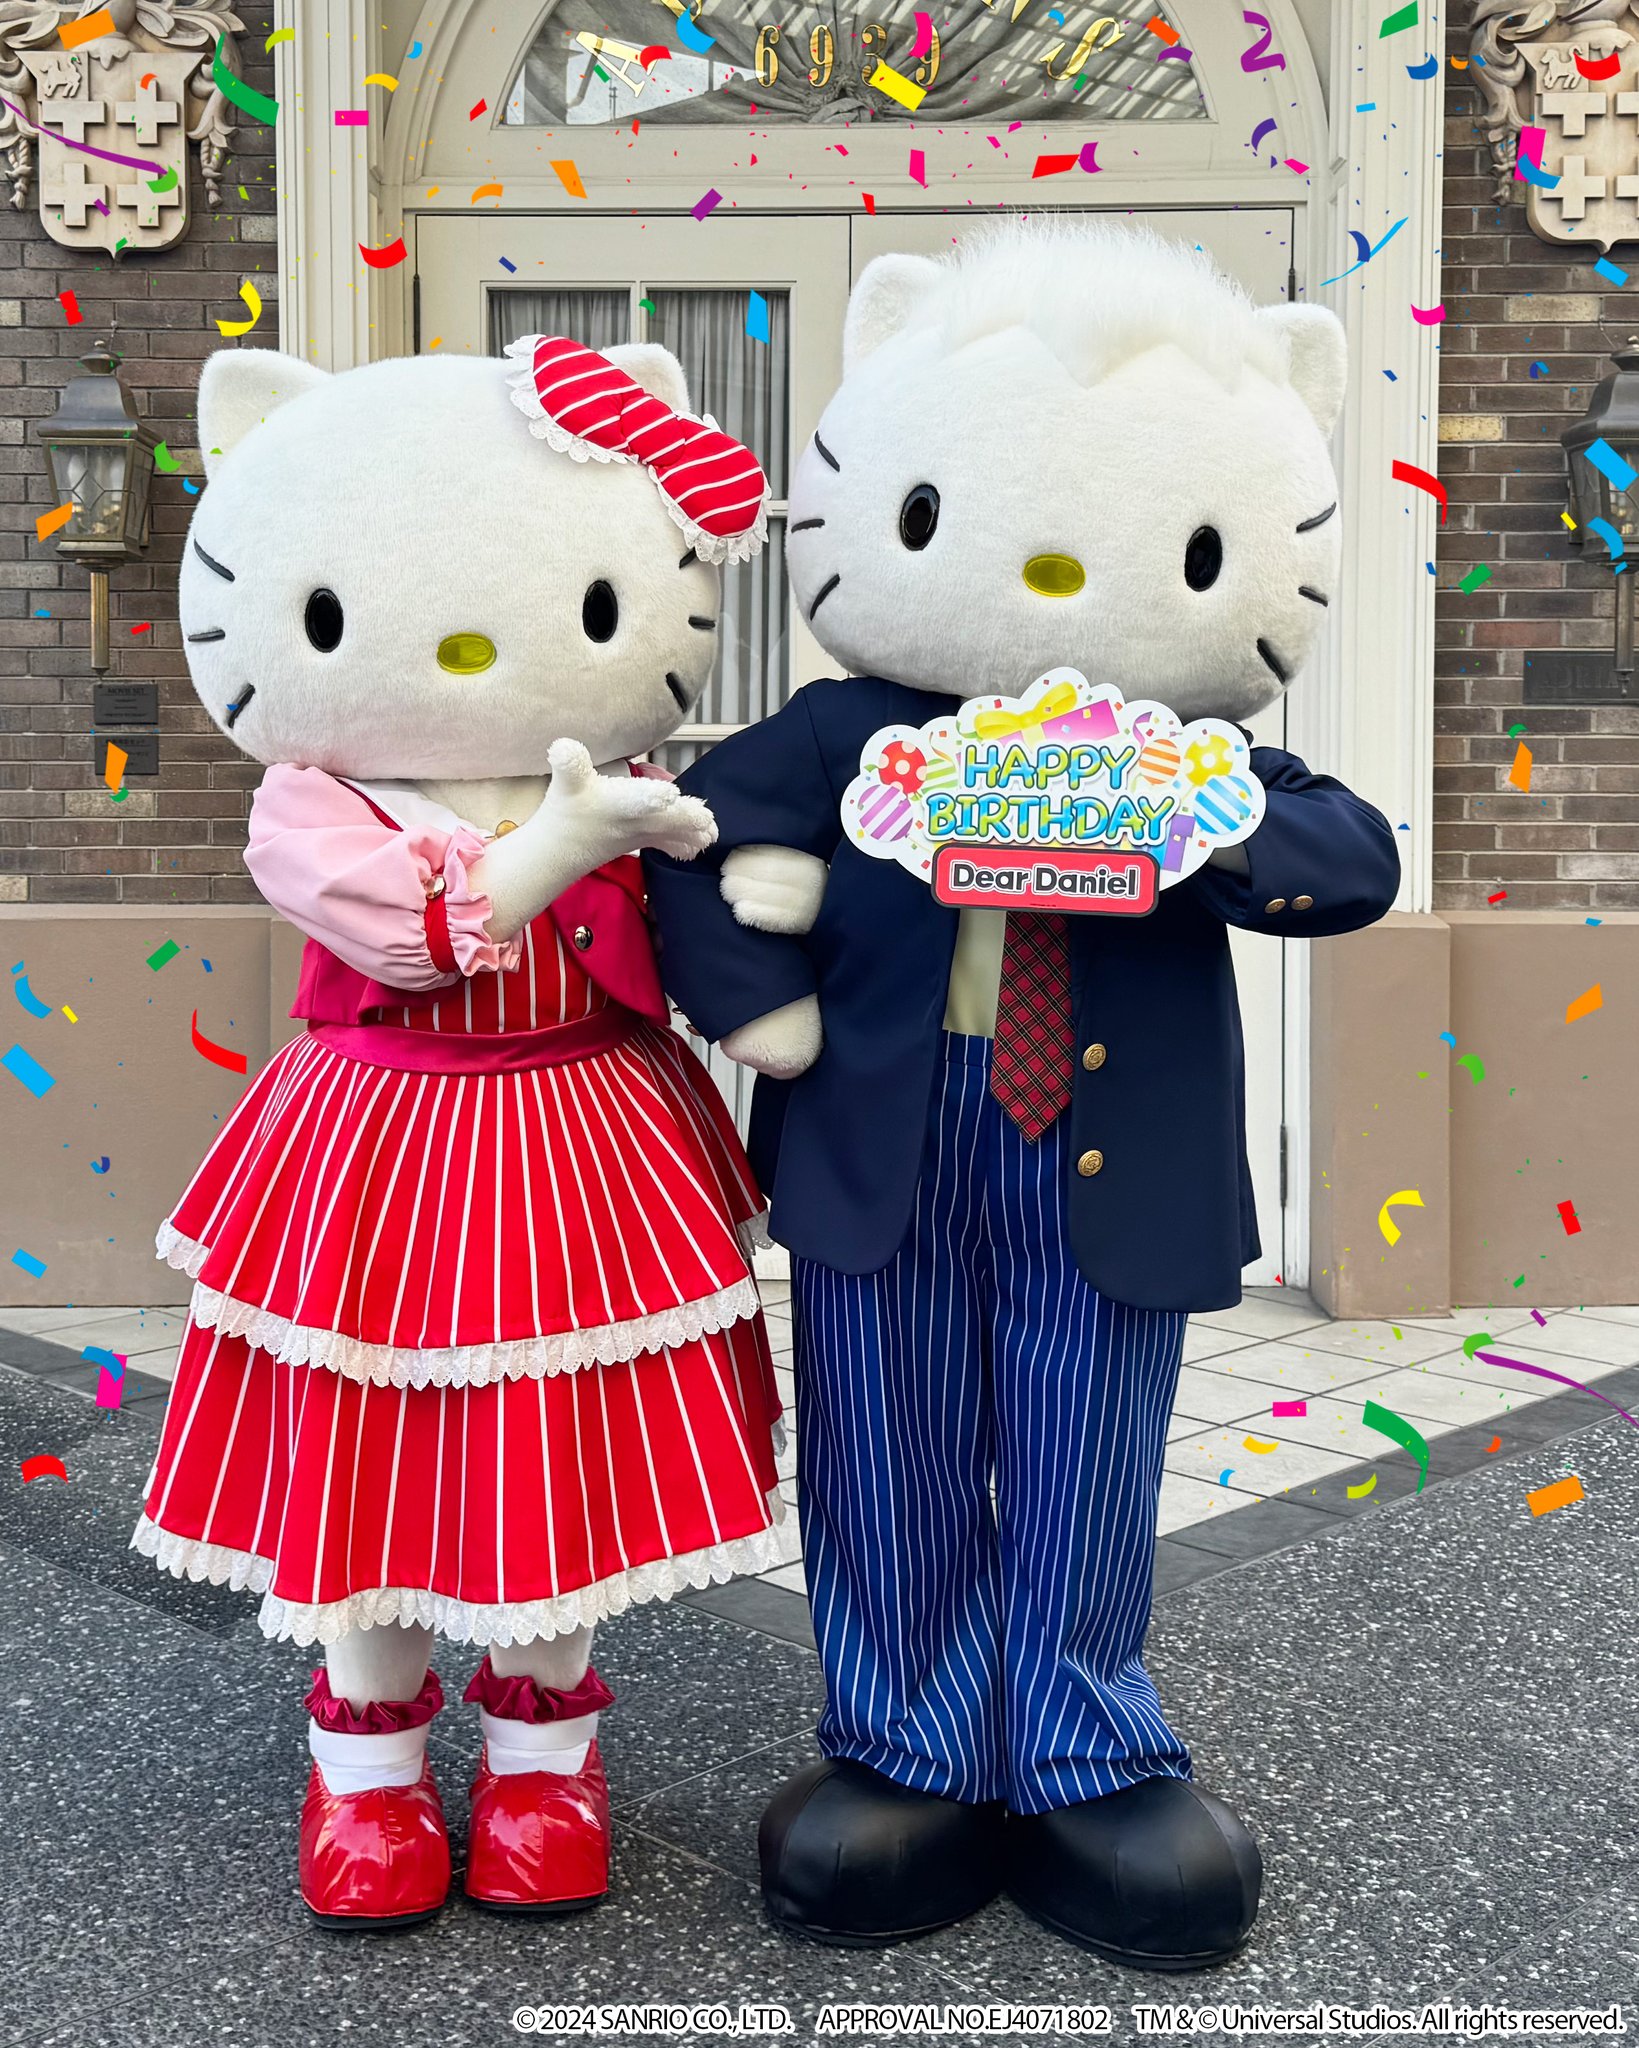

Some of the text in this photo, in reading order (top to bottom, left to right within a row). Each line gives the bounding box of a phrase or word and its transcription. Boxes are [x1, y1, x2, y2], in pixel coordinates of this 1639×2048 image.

[754, 24, 941, 88] 6939
[964, 744, 1136, 790] HAPPY
[926, 793, 1175, 841] BIRTHDAY
[952, 863, 1137, 896] Dear Daniel
